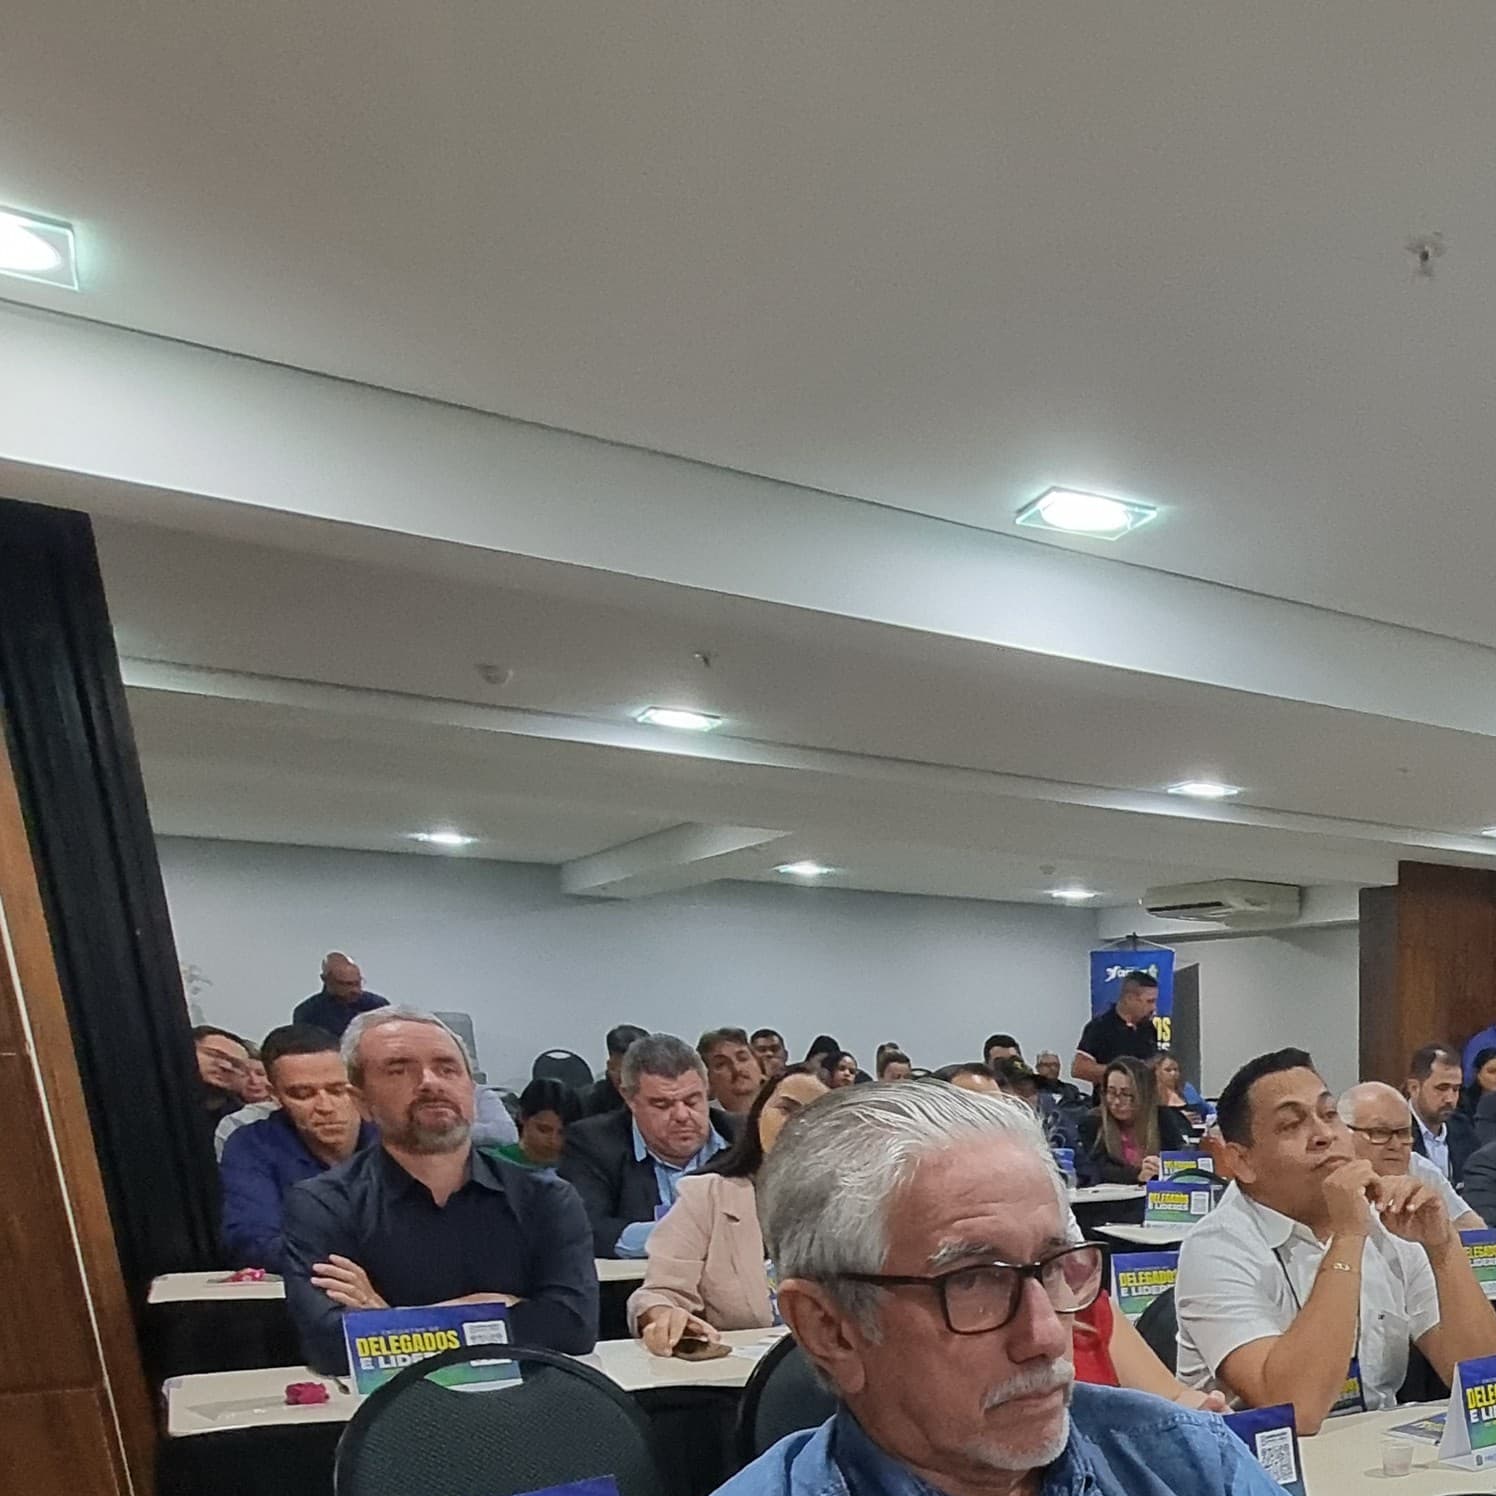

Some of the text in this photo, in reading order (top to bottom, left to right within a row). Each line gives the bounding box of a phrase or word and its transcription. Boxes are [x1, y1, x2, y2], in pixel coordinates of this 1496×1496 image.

[356, 1330, 460, 1357] DELEGADOS
[360, 1352, 430, 1370] E LIDE
[1470, 1409, 1479, 1423] E
